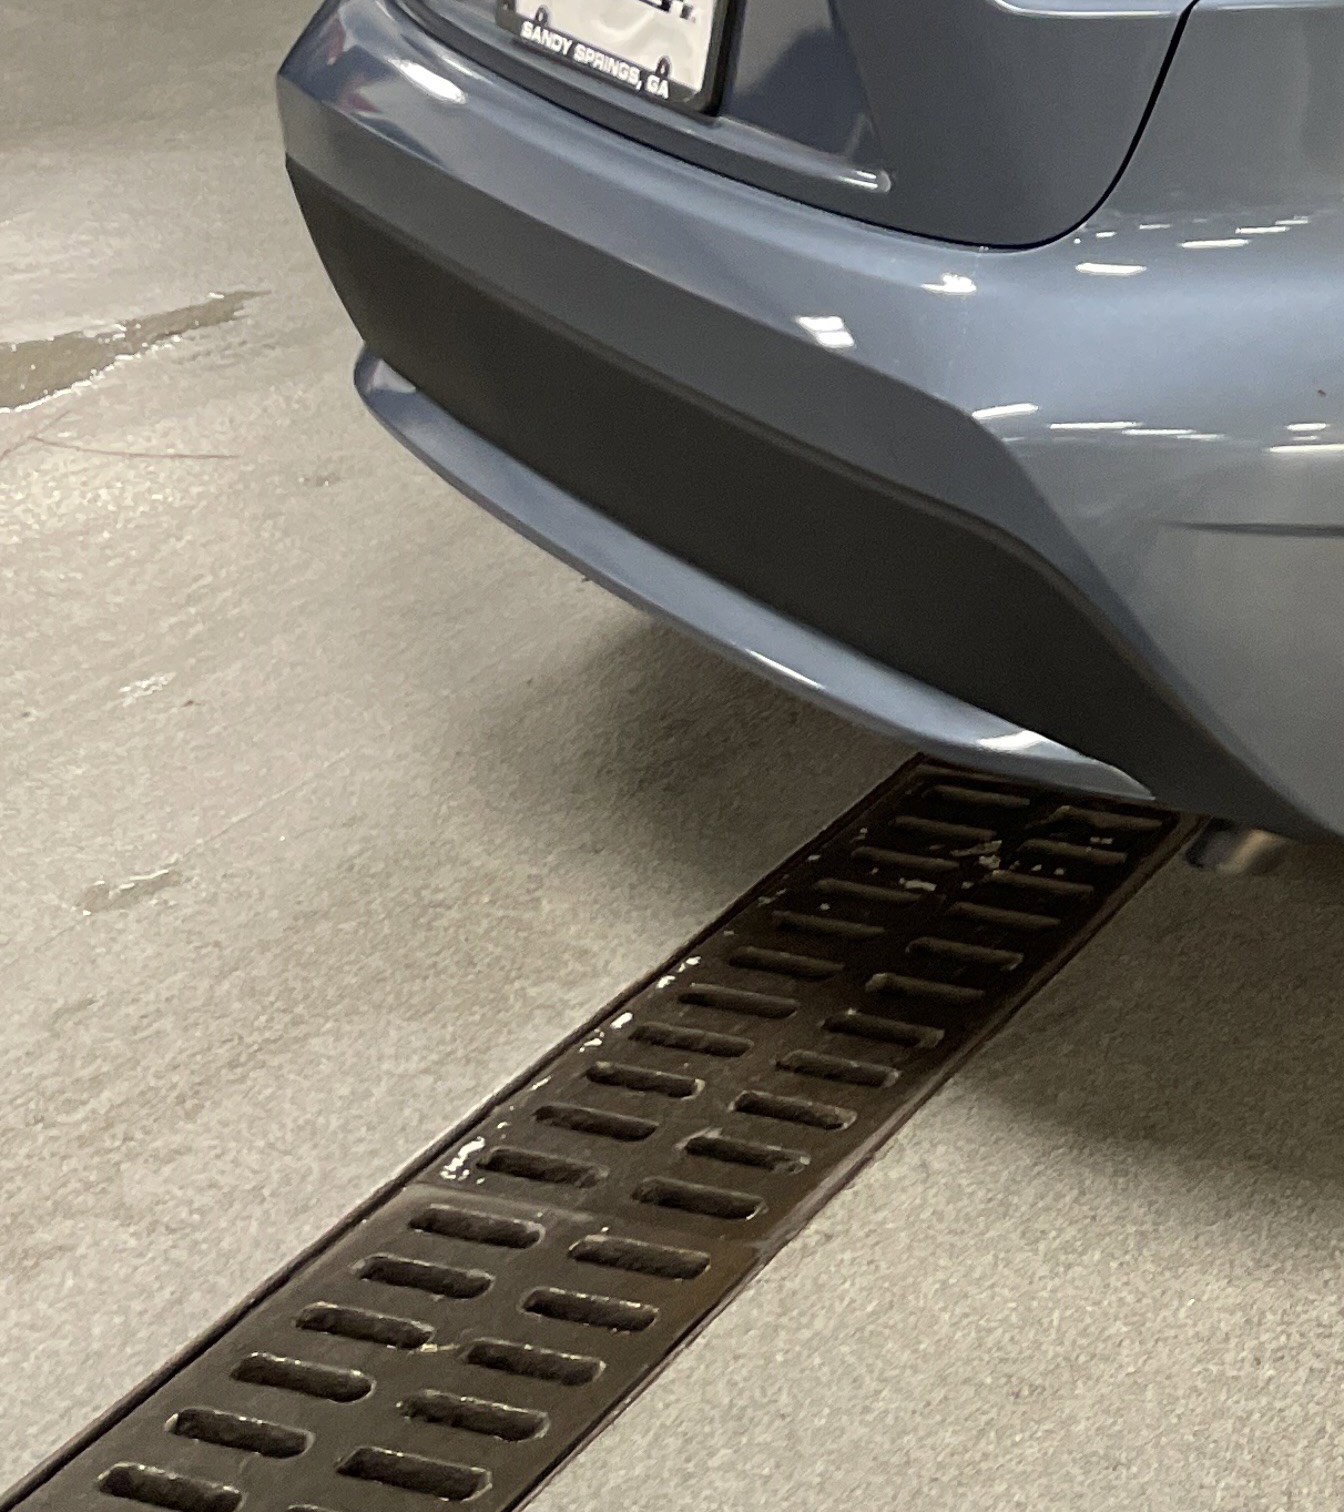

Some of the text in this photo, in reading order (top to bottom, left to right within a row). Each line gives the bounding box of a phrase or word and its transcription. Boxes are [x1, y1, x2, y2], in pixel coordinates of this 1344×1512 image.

[521, 21, 670, 99] SANDY SPRINGS, GA
